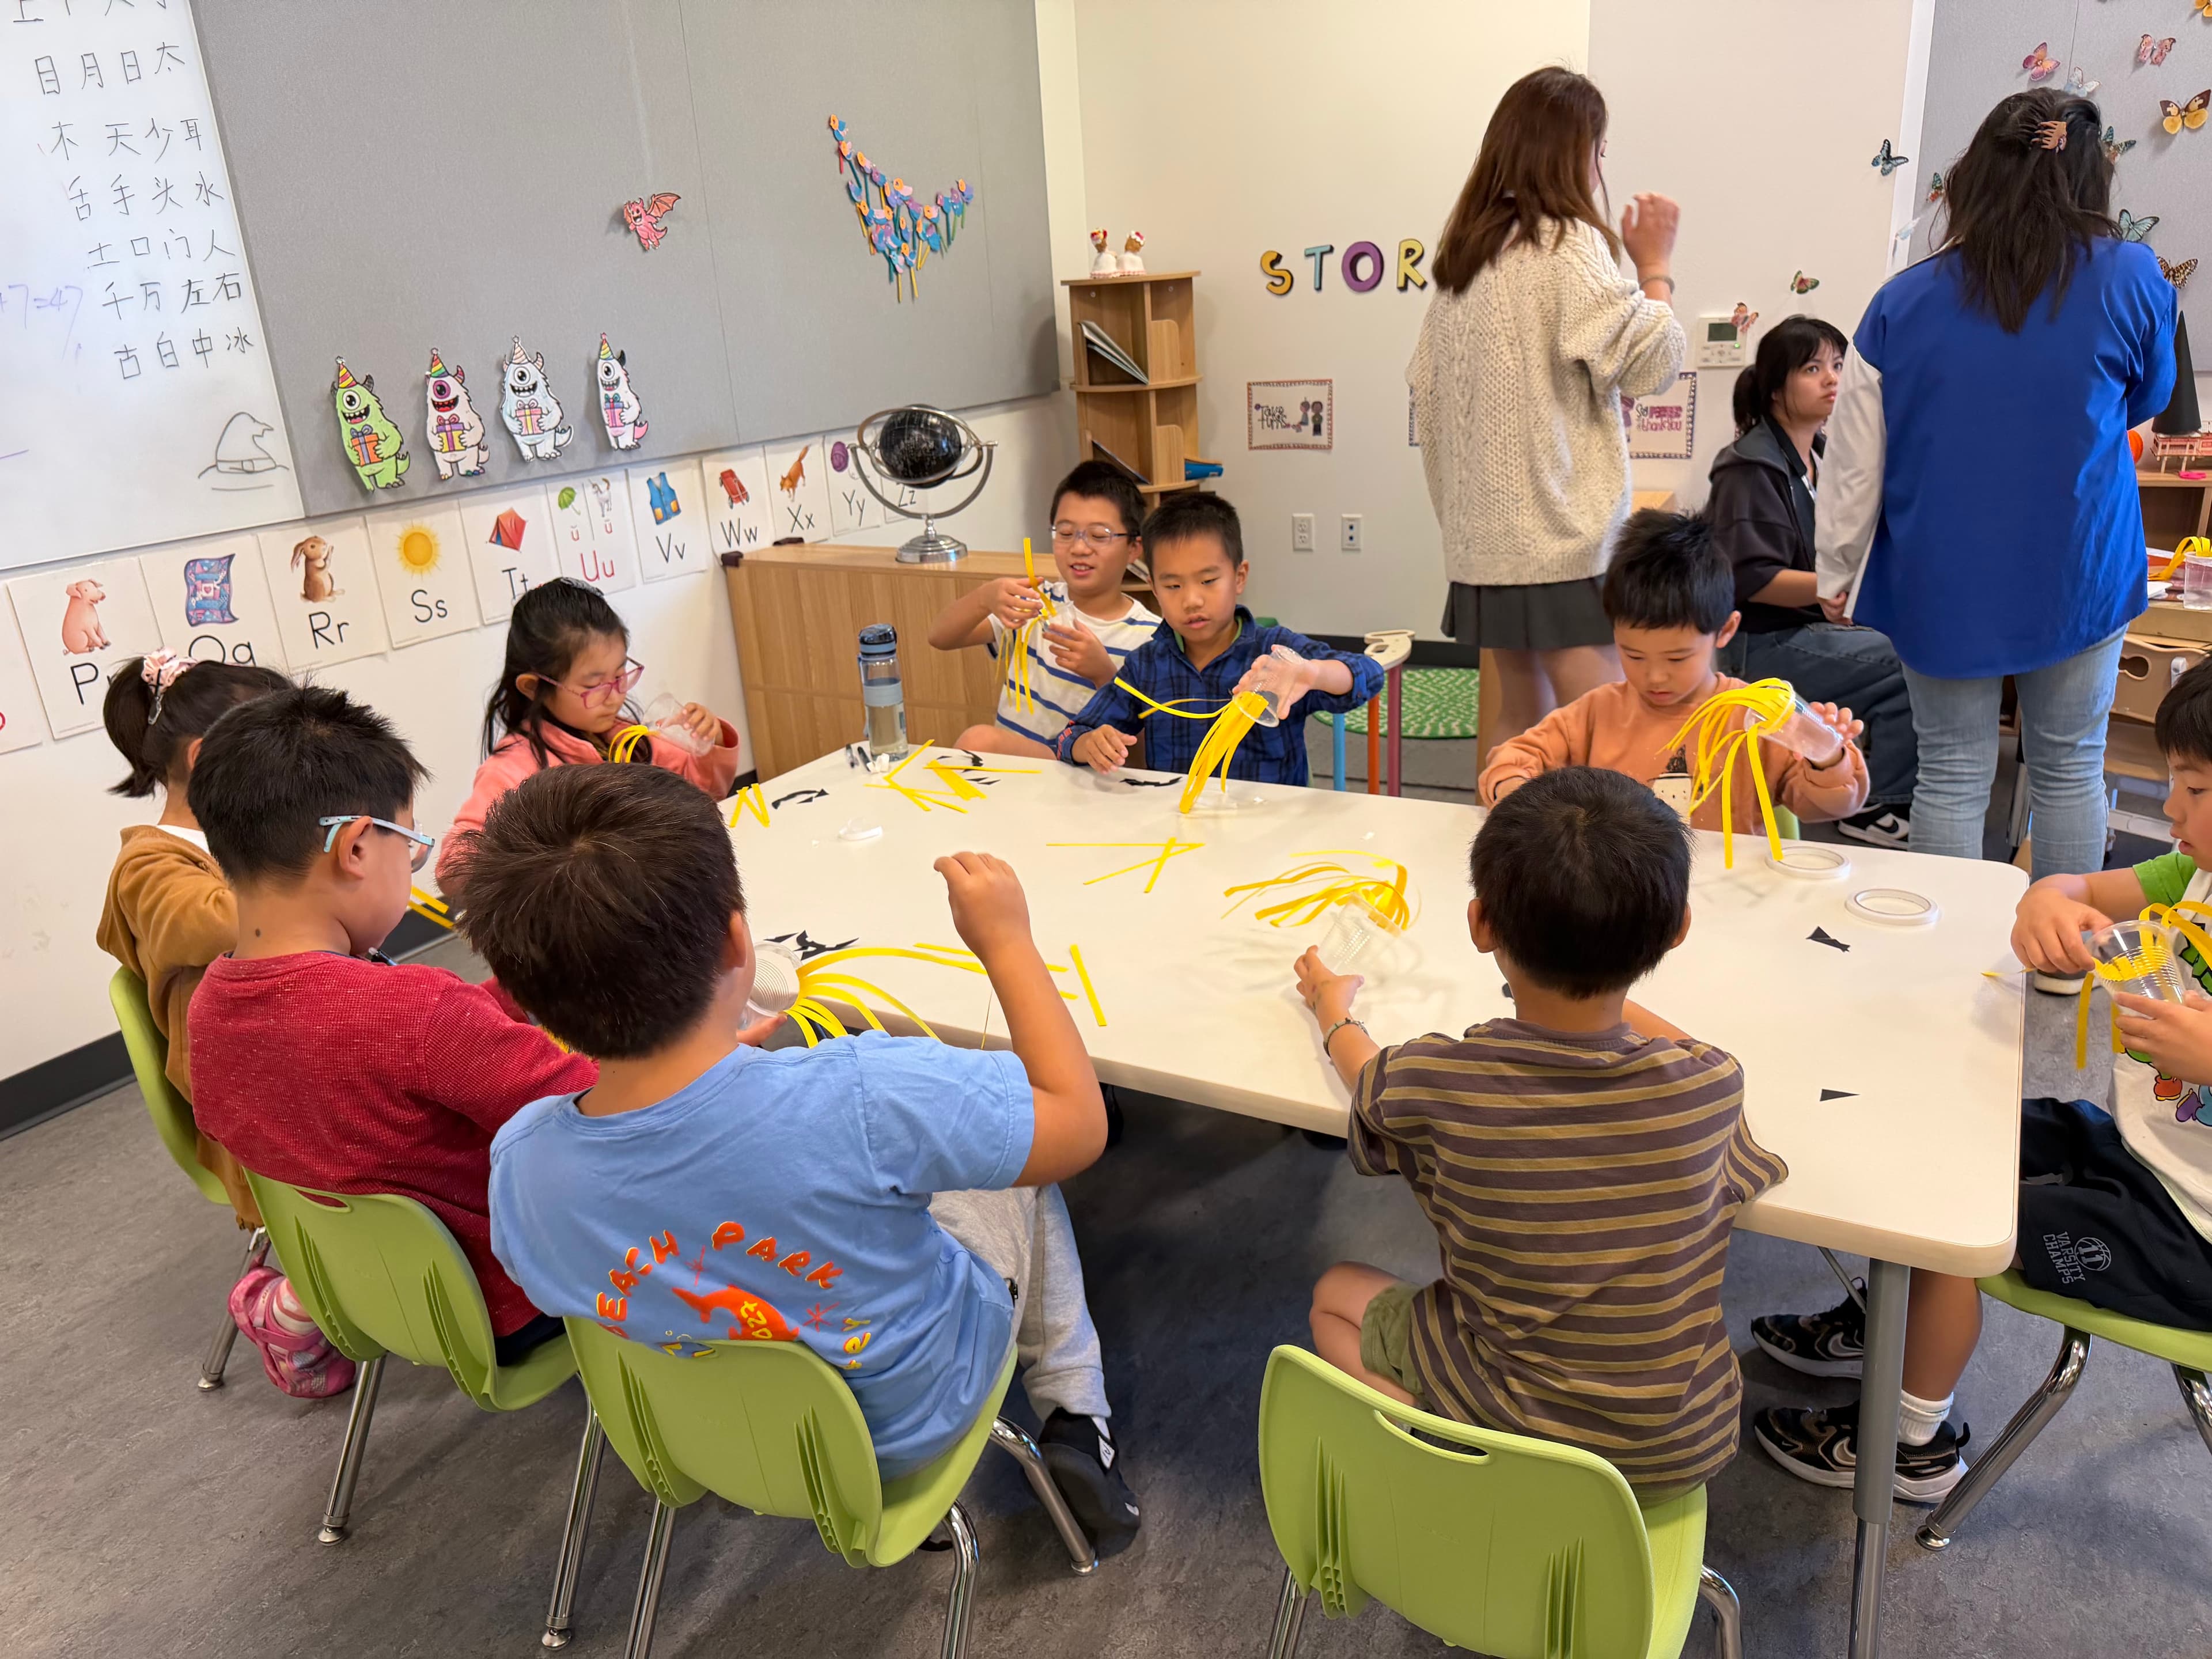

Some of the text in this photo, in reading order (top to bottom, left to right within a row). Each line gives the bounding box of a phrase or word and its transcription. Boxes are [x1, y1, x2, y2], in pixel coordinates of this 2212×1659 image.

[1260, 238, 1427, 296] STOR
[787, 504, 815, 533] Xx
[842, 490, 865, 527] Yy
[656, 533, 685, 564] Vv
[721, 517, 758, 548] Ww
[502, 567, 528, 600] Tt
[580, 550, 615, 582] Uu
[411, 589, 448, 623] Ss
[309, 611, 350, 650] Rr
[2043, 1234, 2074, 1284] CHAMPS
[2056, 1231, 2086, 1281] VARSITY
[597, 1221, 843, 1340] EACH PARK
